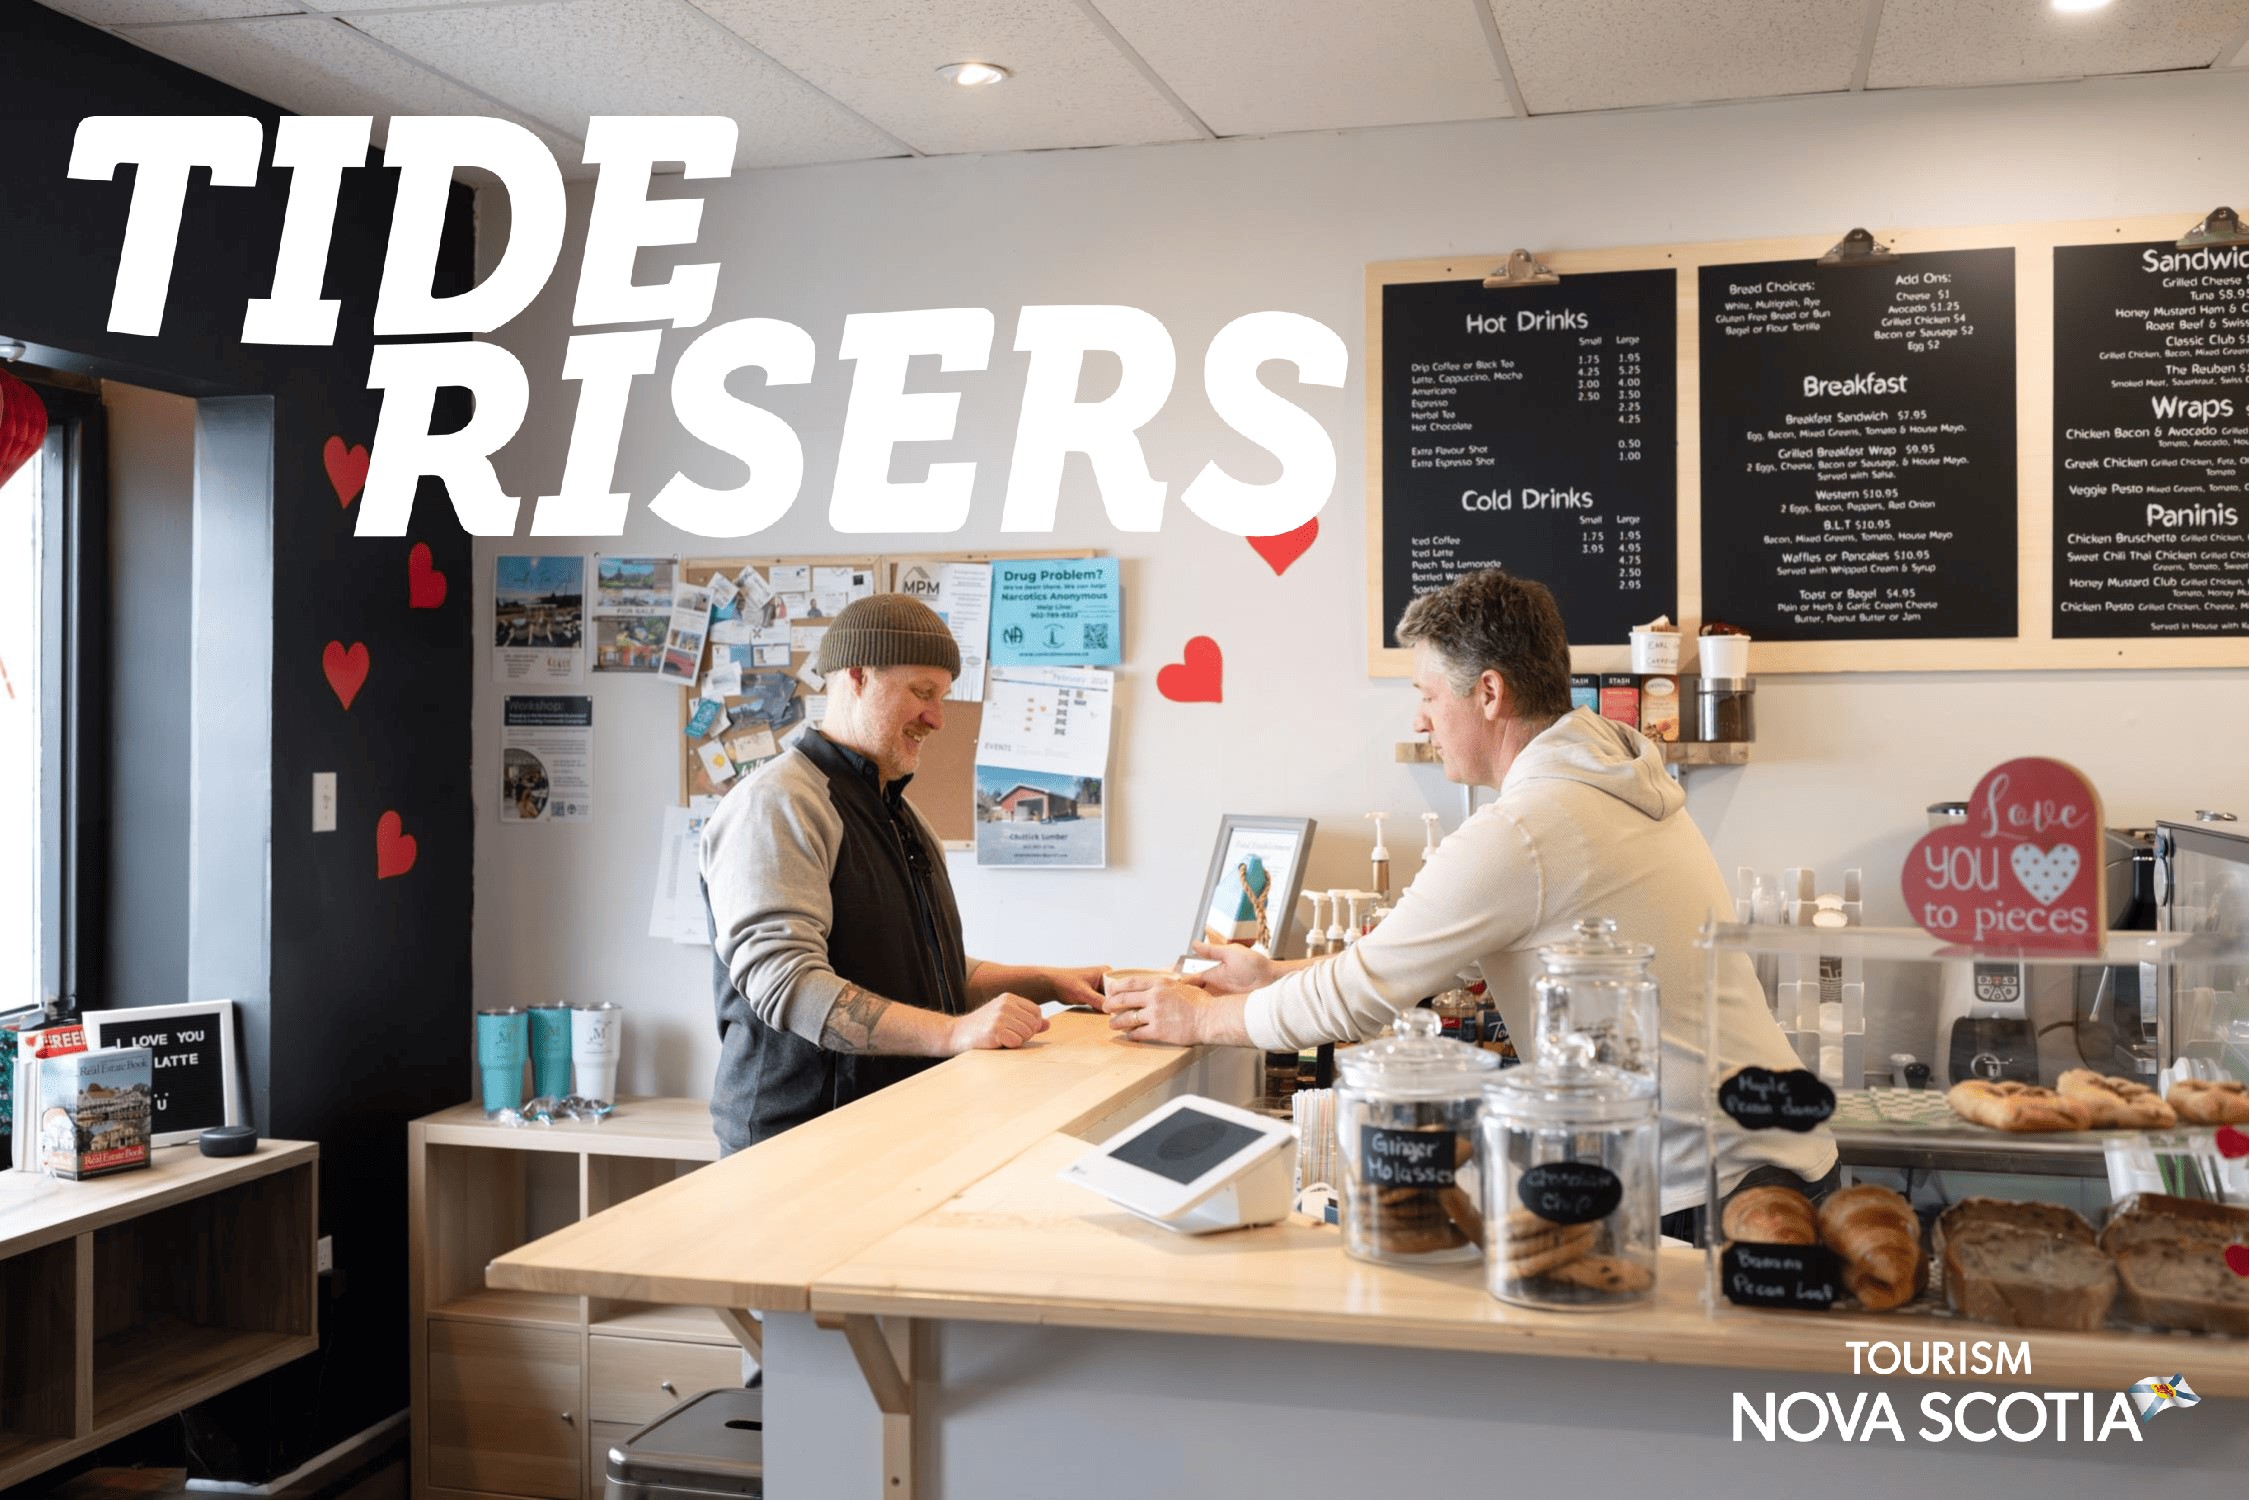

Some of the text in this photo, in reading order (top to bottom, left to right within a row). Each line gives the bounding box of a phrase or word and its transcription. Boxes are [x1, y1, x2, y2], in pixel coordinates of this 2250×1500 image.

[1895, 272, 1951, 285] Add Ons:
[2162, 276, 2242, 288] Grilled Cheese
[1729, 281, 1815, 295] Bread Choices:
[1896, 289, 1950, 301] Cheese $1
[2190, 291, 2215, 301] Tuna
[1888, 301, 1960, 314] Avocado $1.25
[2115, 304, 2237, 319] Honey Mustard Ham &
[1466, 309, 1588, 334] Hot Drinks
[1715, 309, 1831, 324] Gluten Free Bread or Bun
[2146, 321, 2175, 331] Roast
[2179, 319, 2204, 330] Beef
[2209, 318, 2217, 329] &
[1907, 339, 1940, 352] Egg $2
[2165, 334, 2235, 347] Classic Club
[1579, 352, 1640, 365] 1.75 1.95
[1411, 363, 1430, 373] Drip
[1432, 362, 1460, 371] Coffee
[1476, 360, 1497, 369] Black
[1500, 359, 1515, 368] Tea
[1578, 365, 1641, 376] 4.25 5.25
[2165, 363, 2236, 375] The Reuben
[1493, 372, 1523, 380] Mocha
[1578, 378, 1640, 389] 3.00 4.00
[1803, 372, 1908, 397] Breakfast
[1578, 390, 1641, 401] 2.50 3.50
[1619, 401, 1641, 412] 2.25
[2152, 396, 2234, 424] Wraps
[1618, 414, 1641, 424] 4.25
[1785, 410, 1927, 425] Breakfast Sandwich $7.95
[2066, 426, 2217, 440] Chicken Bacon & Avocado
[1618, 439, 1641, 448] 0.50
[1619, 451, 1641, 461] 1.00
[1778, 444, 1935, 459] Grilled Breakfast Wrap $9.95
[2064, 457, 2148, 469] Greek Chicken
[1815, 488, 1898, 500] Western $10.95
[2069, 483, 2144, 498] Veggie Pesto
[1462, 487, 1593, 511] Cold Drinks
[2147, 503, 2238, 527] Paninis
[1823, 519, 1891, 530] B.L.T $10.95
[1411, 536, 1461, 546] Iced Coffee
[1583, 530, 1641, 541] 1.75 1.95
[2067, 532, 2177, 544] Chicken Bruschetta
[1582, 543, 1641, 554] 3.95 4.95
[1619, 555, 1641, 565] 4.75
[1782, 550, 1930, 563] Waffles or Pancakes $10.95
[2067, 550, 2197, 562] Sweet Chili Thai Chicken
[1004, 569, 1103, 583] Drug Problem?
[1412, 572, 1443, 582] Bottled
[1619, 568, 1641, 577] 2.50
[903, 581, 940, 595] MPM
[1619, 580, 1641, 590] 2.95
[2069, 576, 2177, 590] Honey Mustard Club
[1001, 592, 1108, 602] Narcotics Anonymous
[1799, 588, 1916, 602] Toast or Bagel $4.95
[2060, 601, 2135, 612] Chicken Pesto
[1981, 772, 2089, 841] Love
[1922, 900, 2089, 942] to pieces
[132, 1033, 168, 1048] LOVE
[176, 1030, 205, 1043] YOU
[80, 1063, 101, 1077] Real
[126, 1057, 149, 1071] Book
[154, 1052, 199, 1069] LATTE
[1371, 1132, 1439, 1164] Ginger
[1366, 1156, 1455, 1183] Molasses
